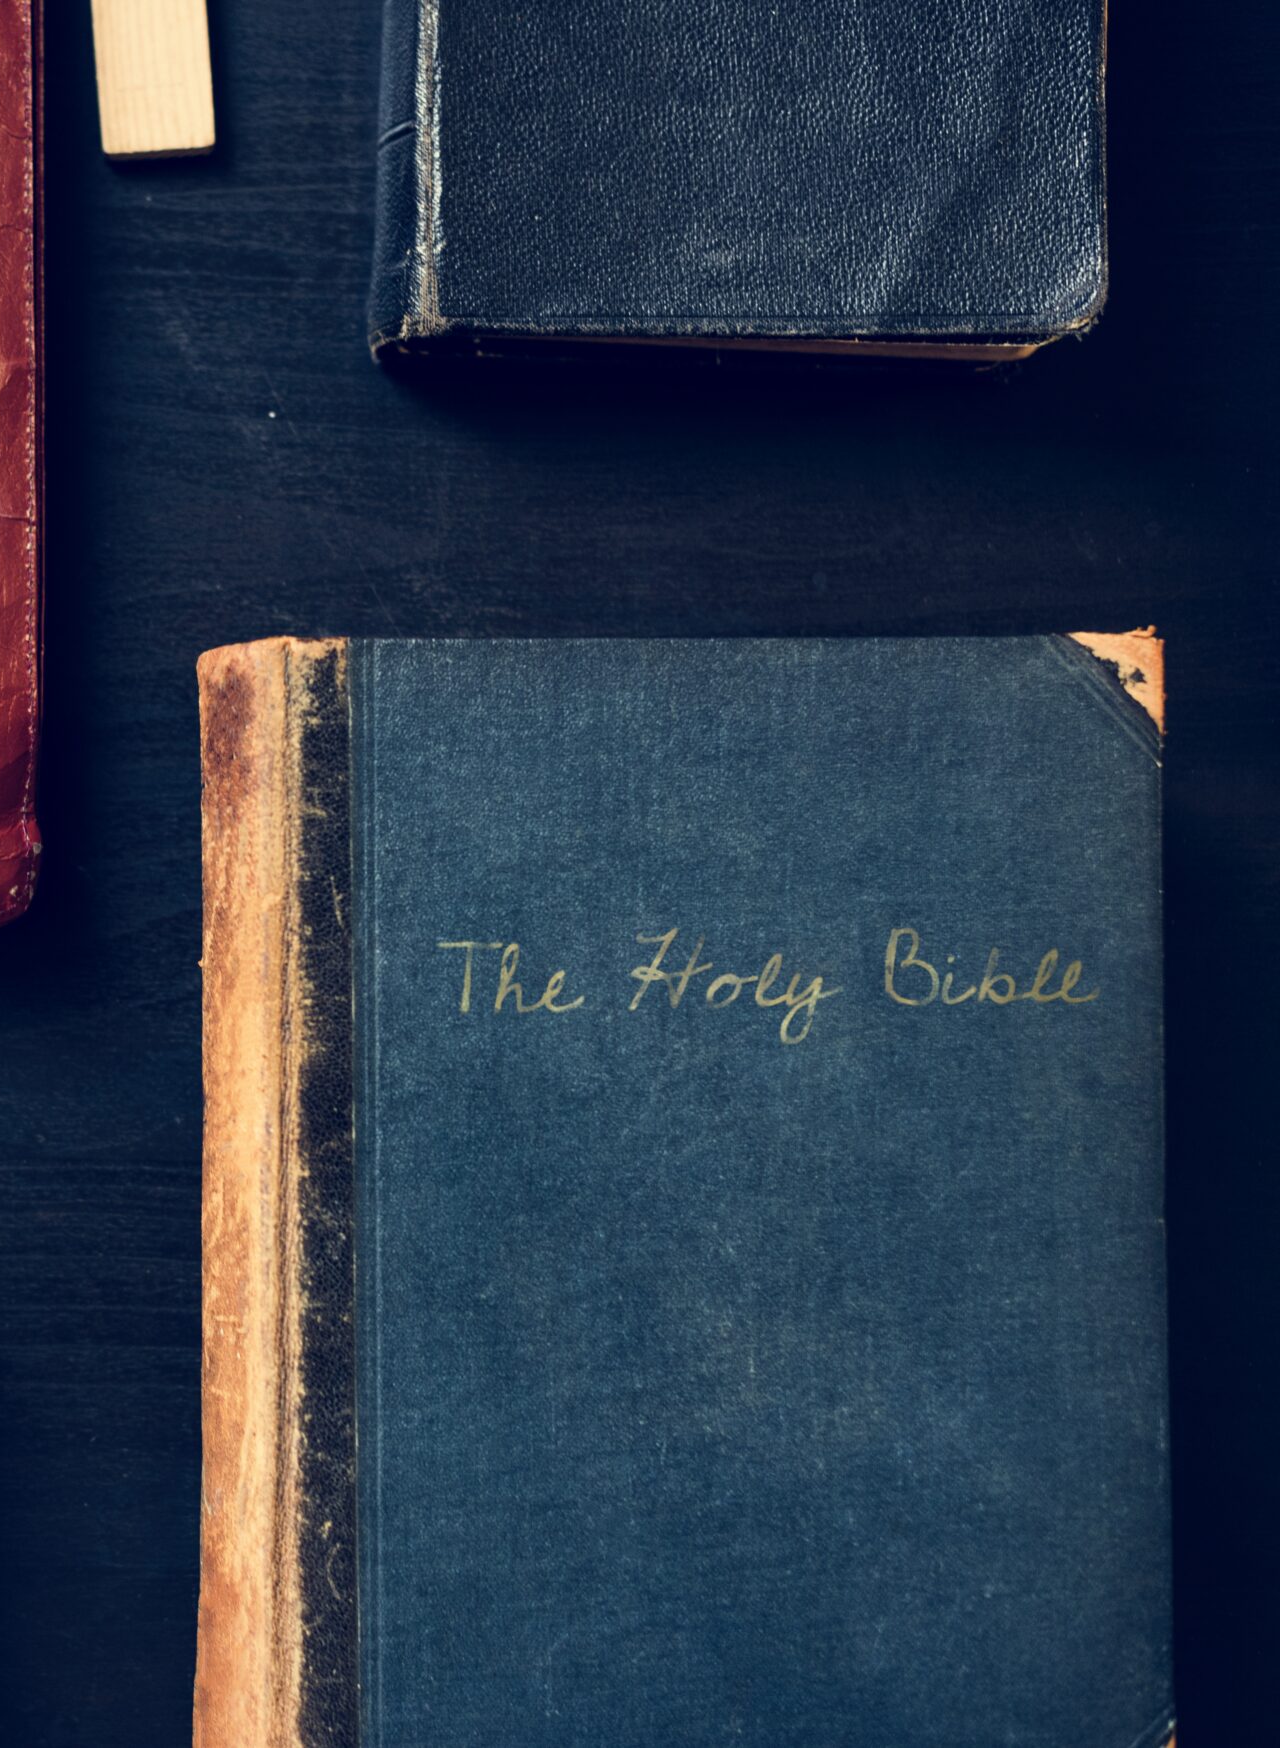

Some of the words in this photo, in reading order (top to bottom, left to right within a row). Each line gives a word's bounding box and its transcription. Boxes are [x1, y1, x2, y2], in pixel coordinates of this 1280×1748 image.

[437, 942, 583, 1013] The
[629, 927, 843, 1044] Holy
[884, 927, 1100, 1006] Bible
